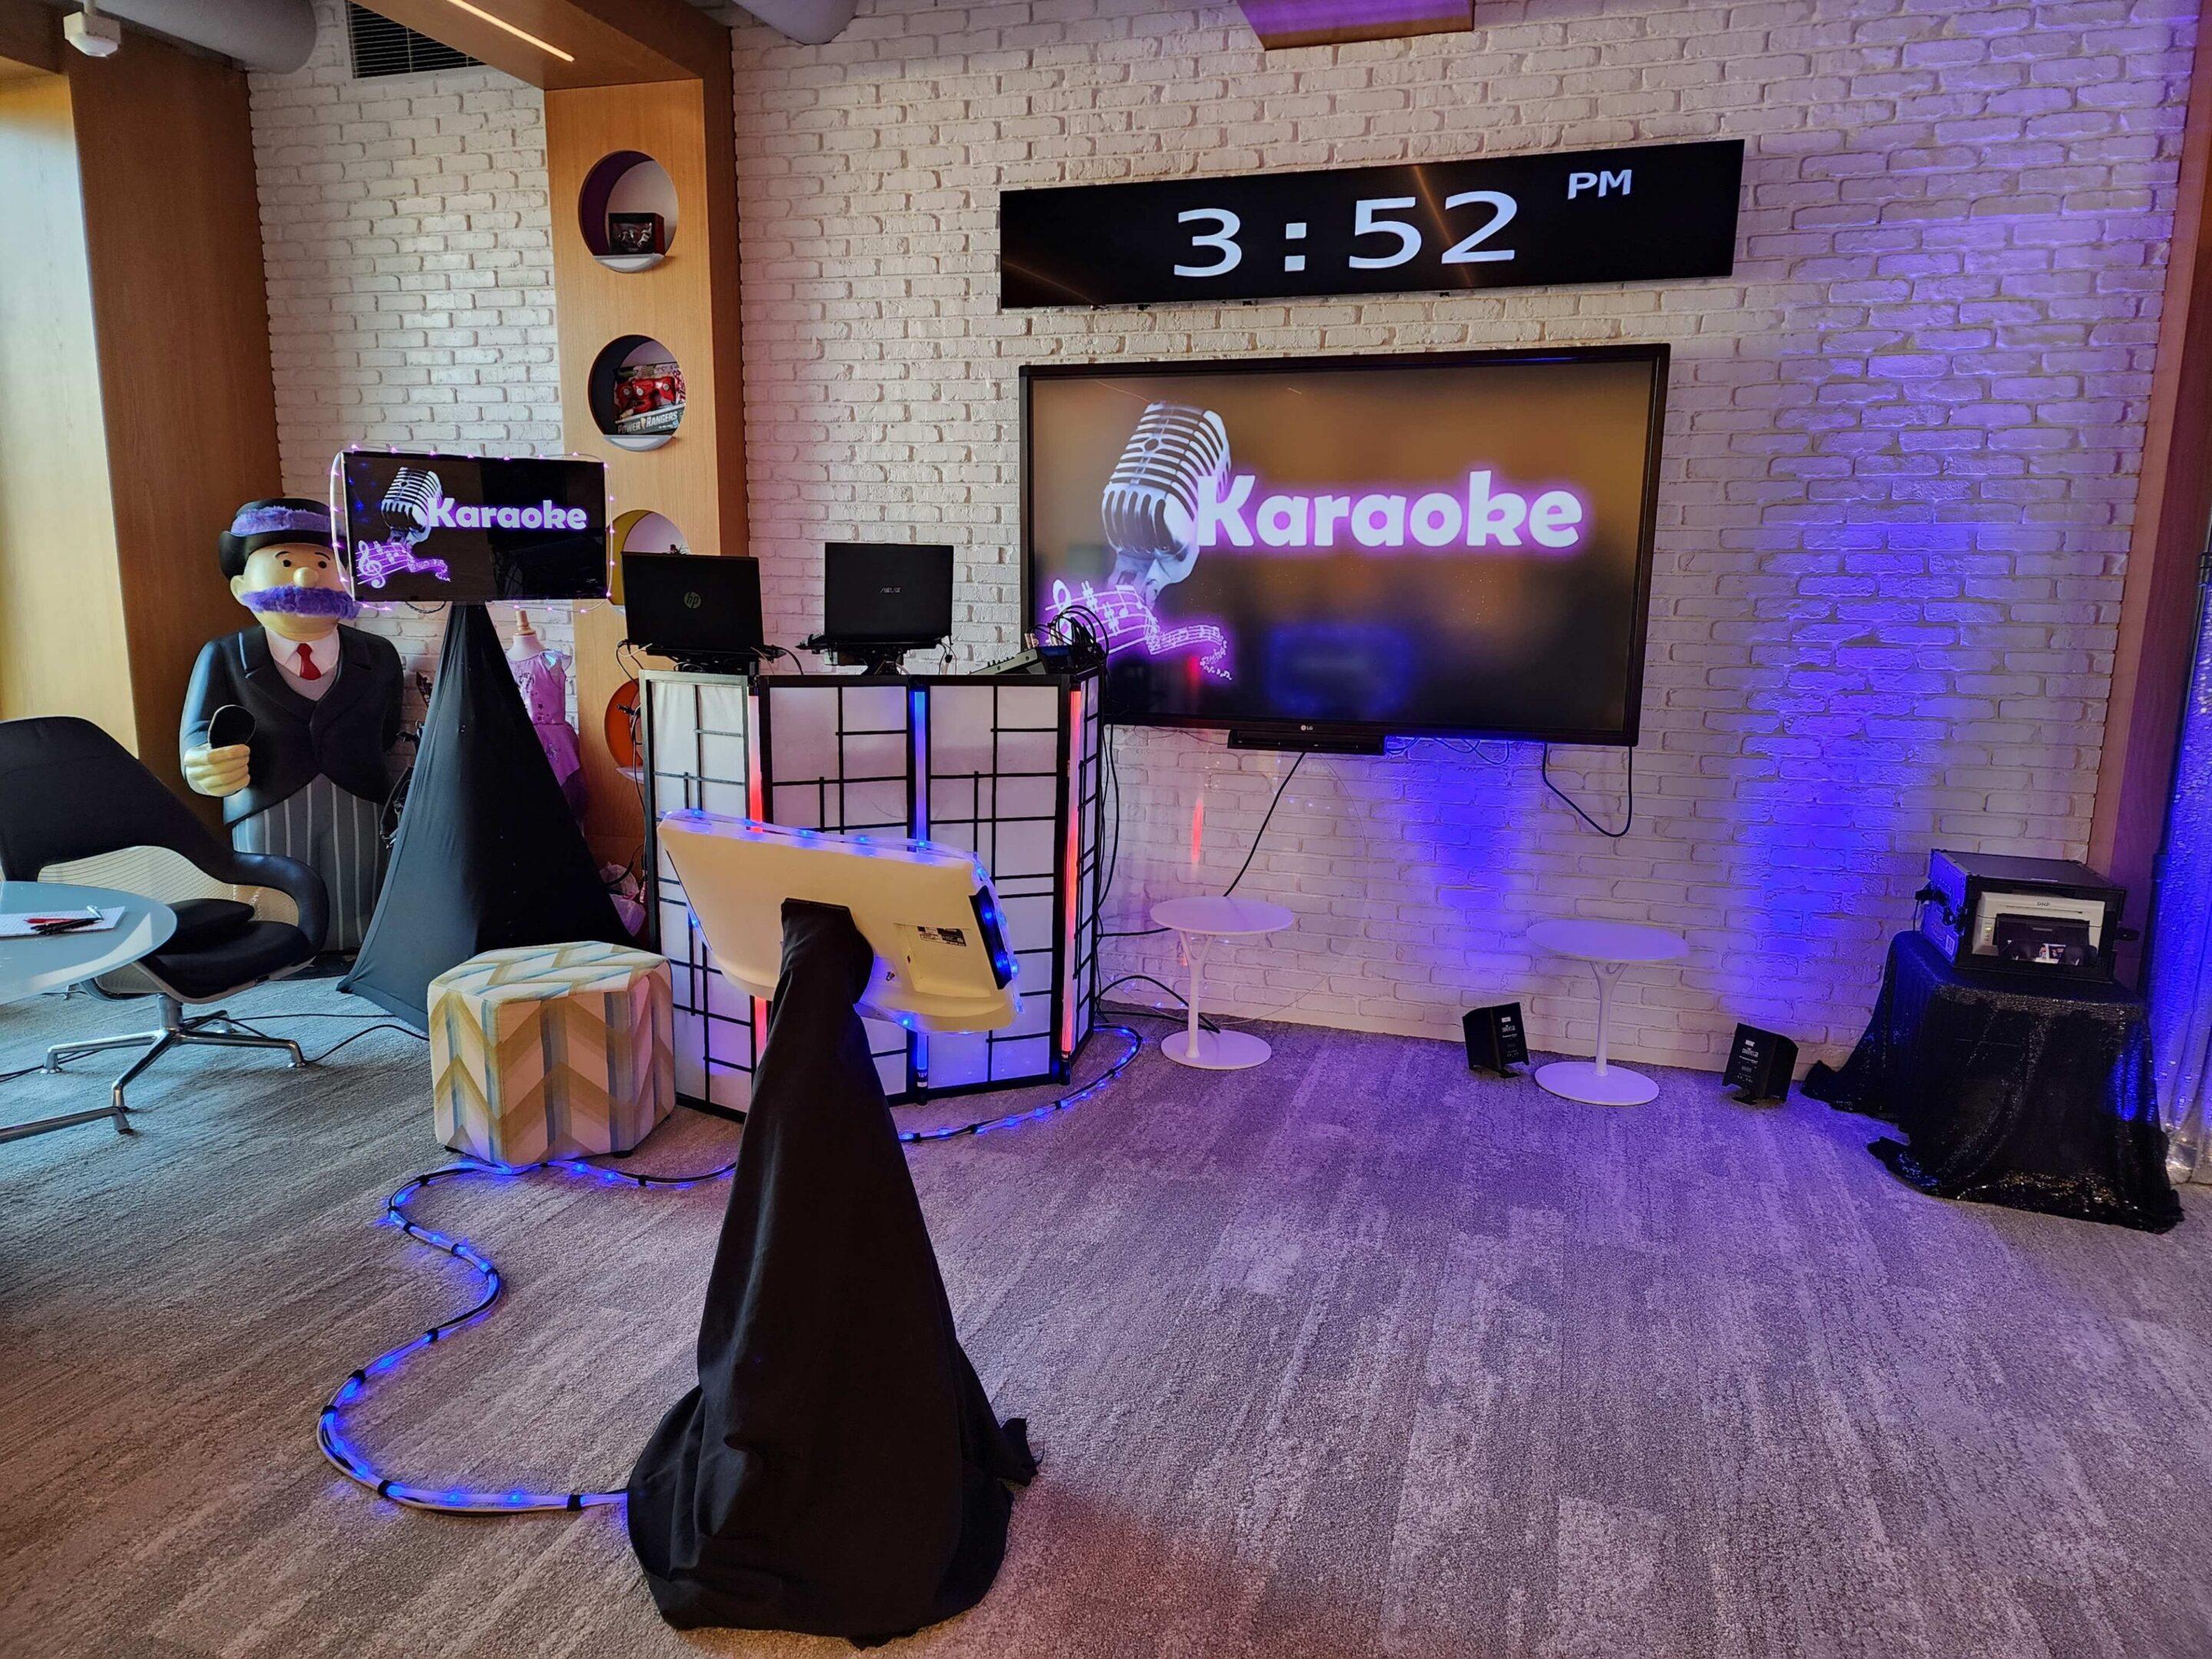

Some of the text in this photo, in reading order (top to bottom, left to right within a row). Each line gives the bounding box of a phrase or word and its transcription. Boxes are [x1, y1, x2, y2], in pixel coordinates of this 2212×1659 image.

[1568, 169, 1633, 200] PM
[618, 411, 678, 434] POWER RANGERS
[427, 498, 588, 530] Karaoke
[1196, 470, 1583, 548] Karaoke
[685, 591, 700, 608] hp
